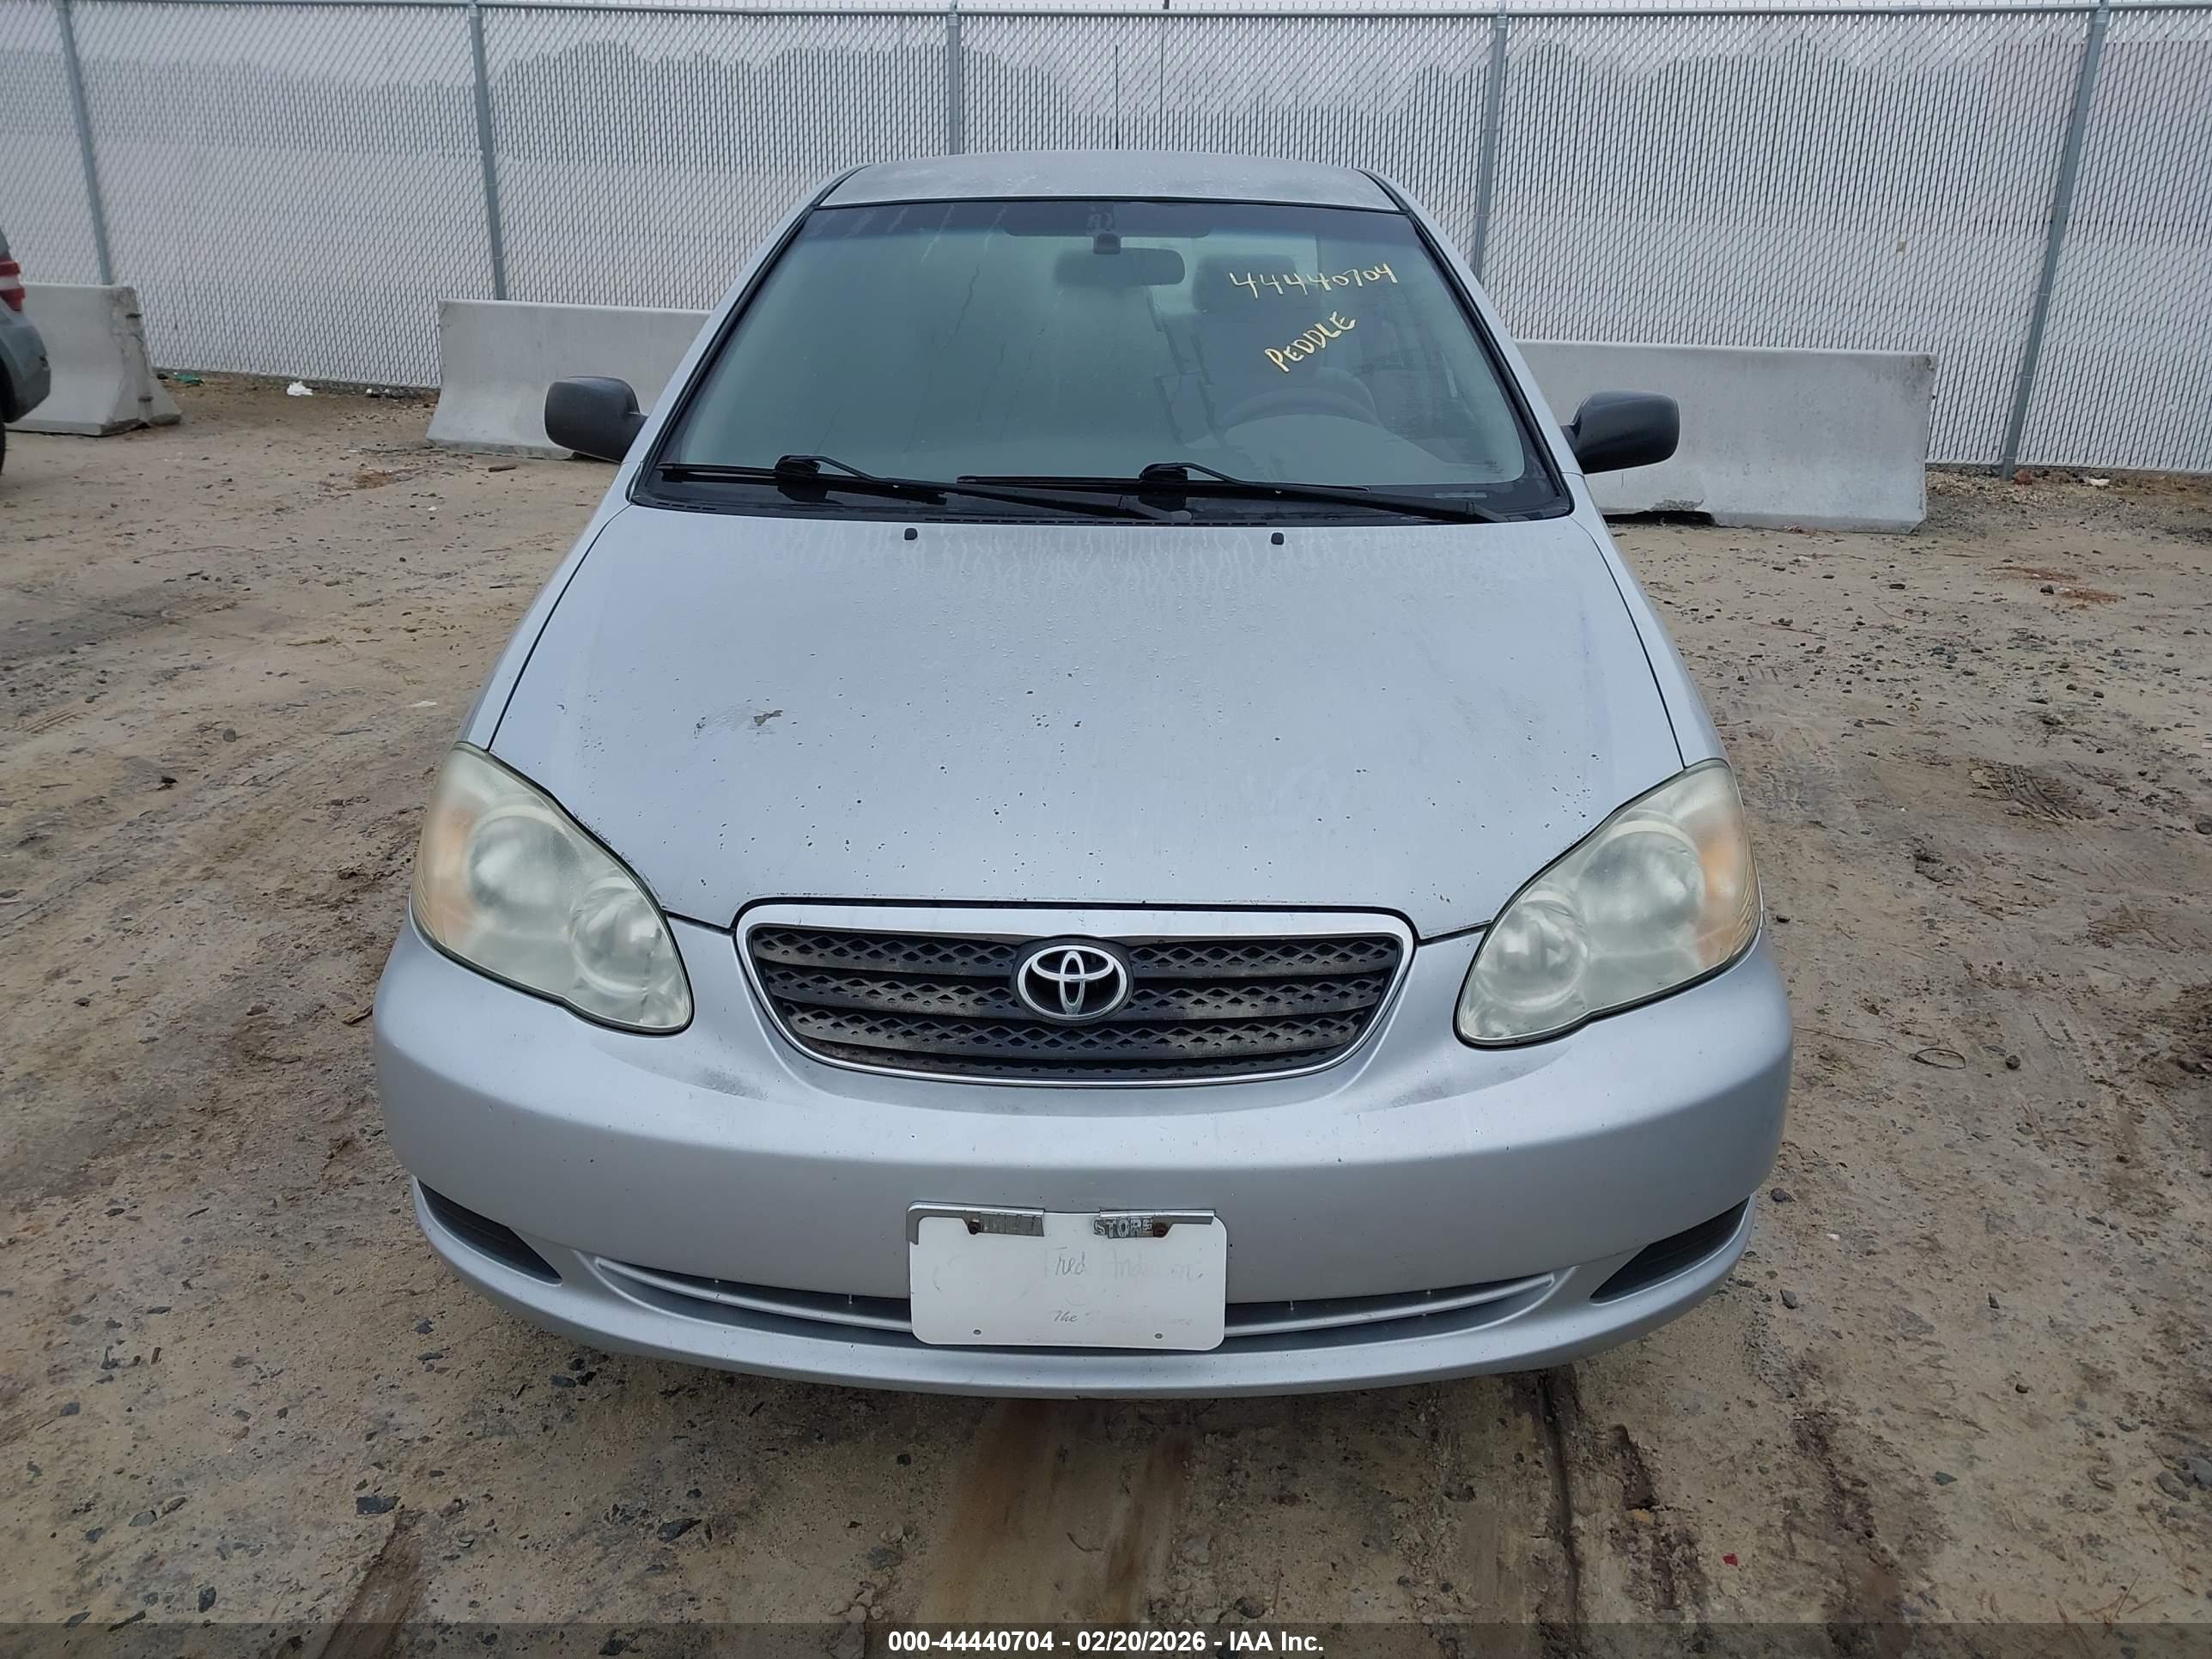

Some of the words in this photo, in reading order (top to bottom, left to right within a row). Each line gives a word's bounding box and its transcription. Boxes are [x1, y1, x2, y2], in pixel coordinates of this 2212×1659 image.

[1229, 263, 1399, 299] 44440704
[1264, 310, 1357, 373] PEDDLE
[1052, 1309, 1080, 1323] The
